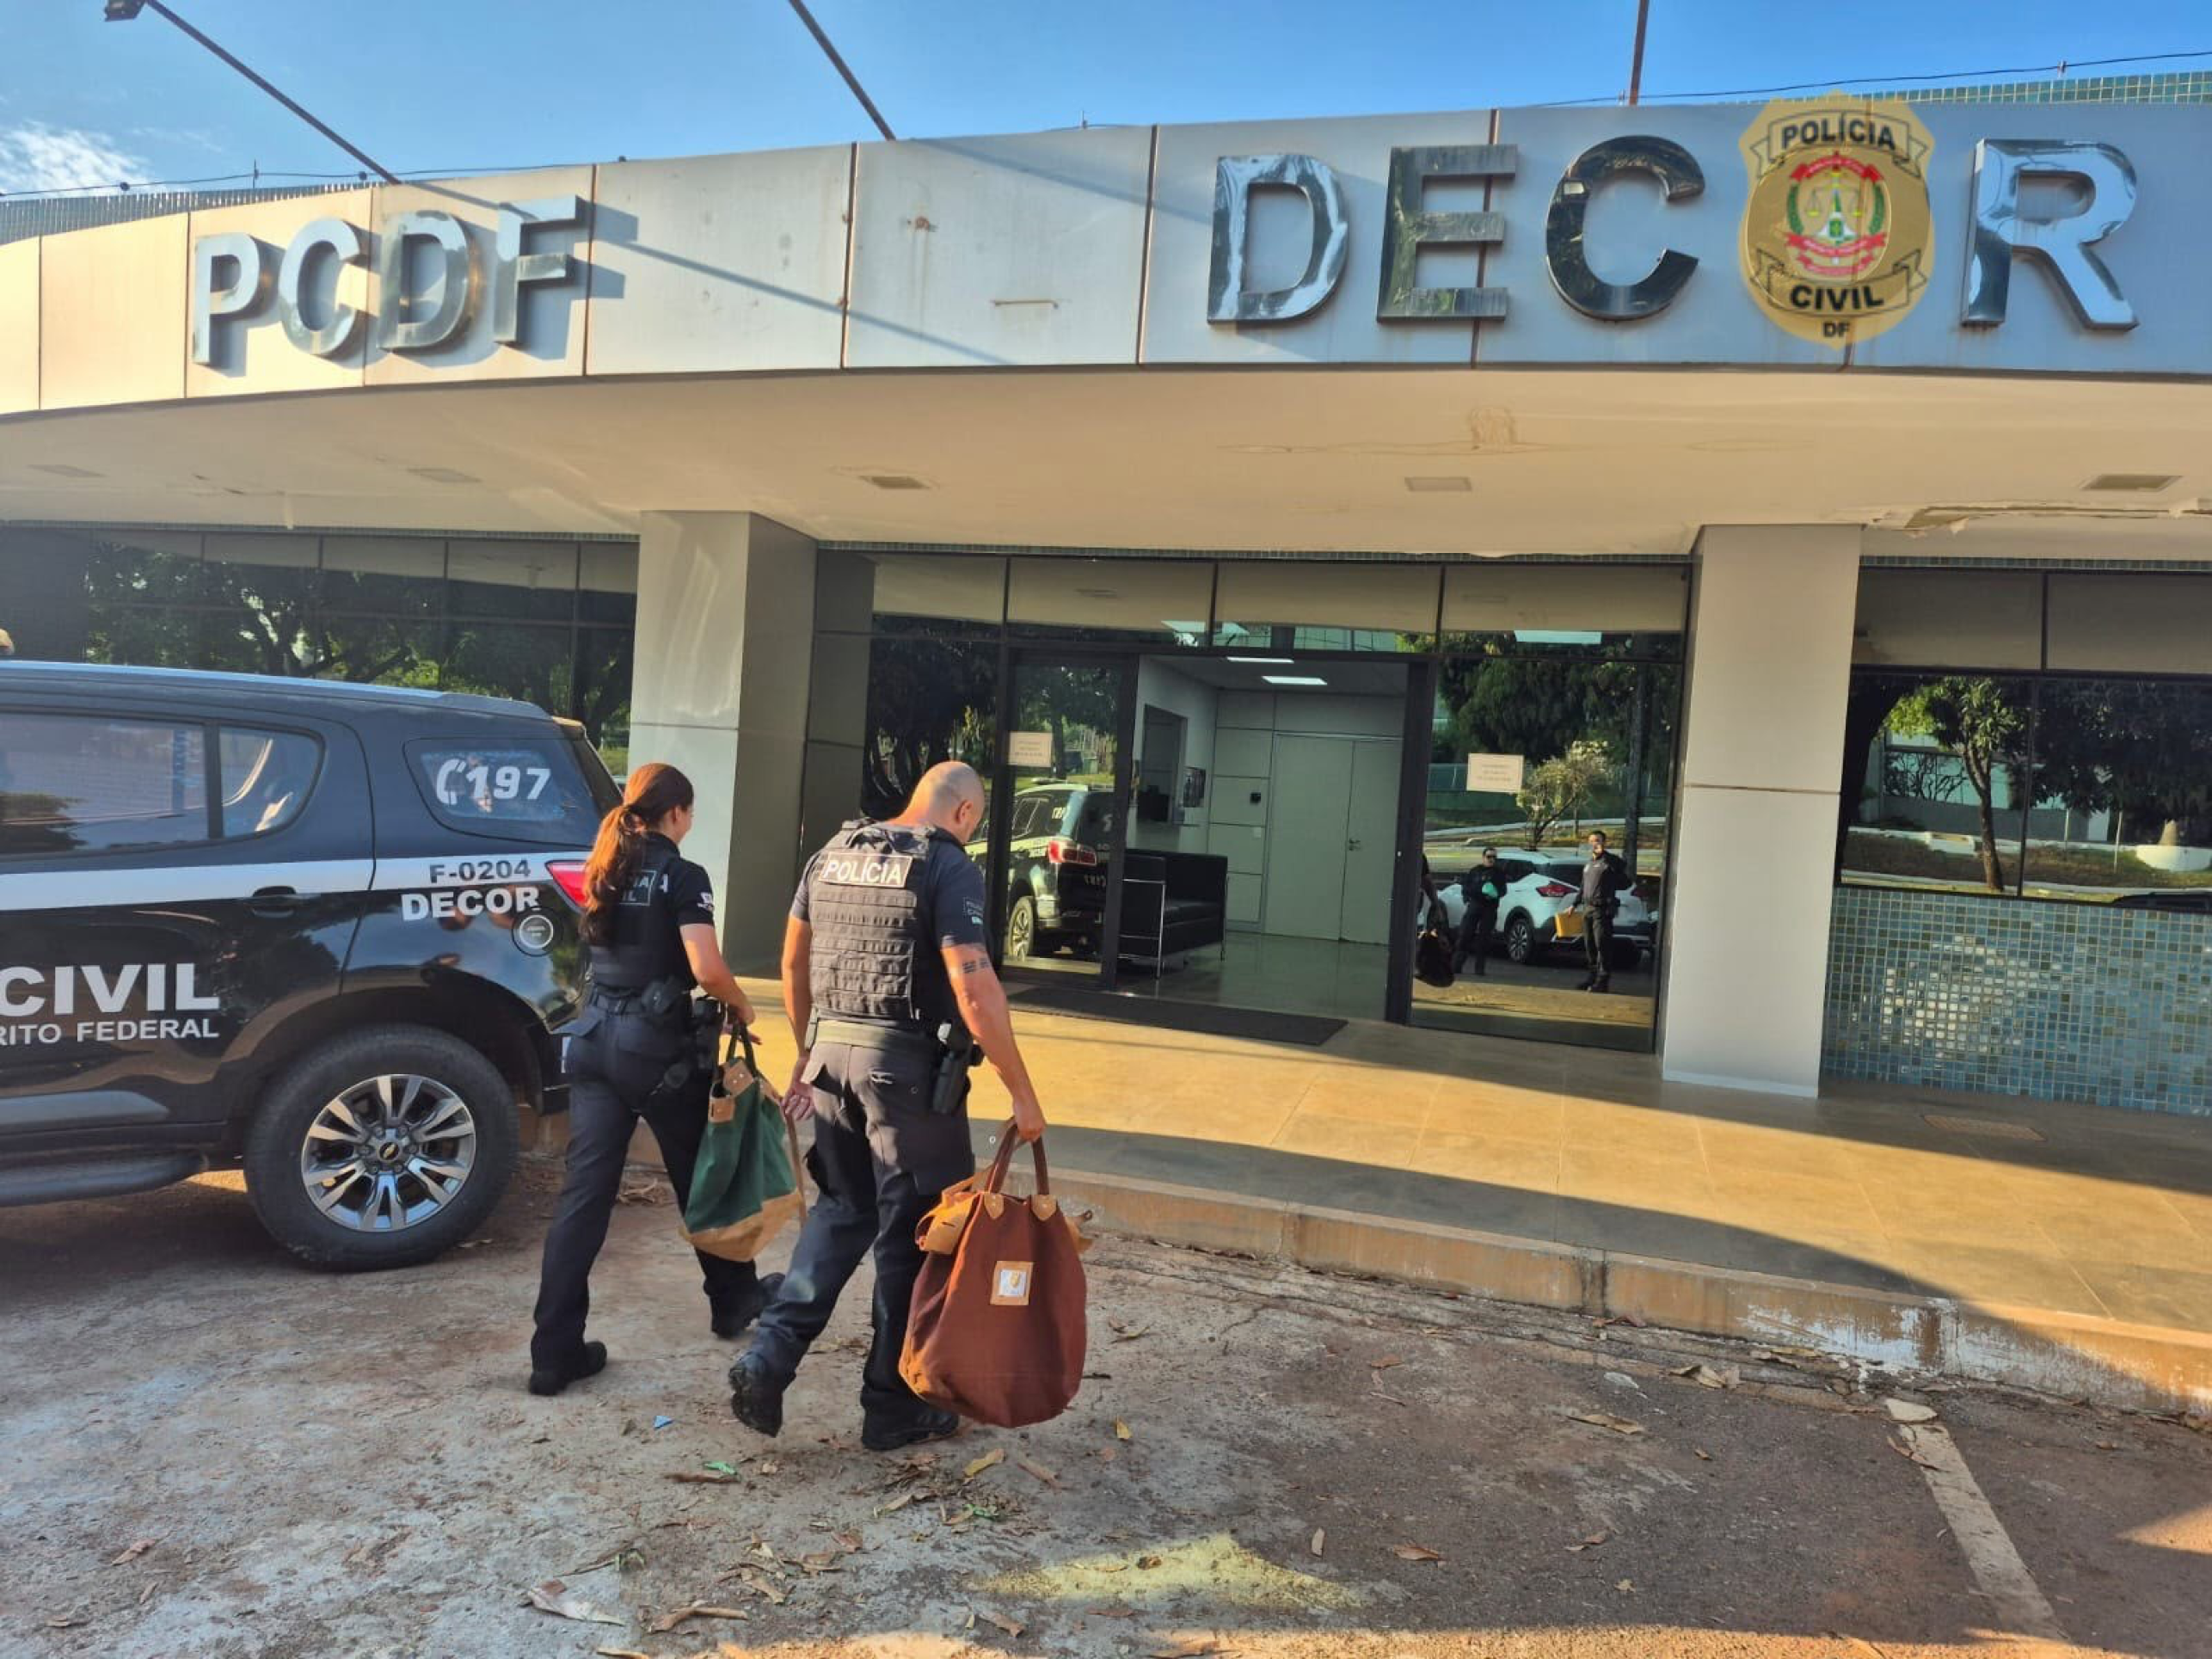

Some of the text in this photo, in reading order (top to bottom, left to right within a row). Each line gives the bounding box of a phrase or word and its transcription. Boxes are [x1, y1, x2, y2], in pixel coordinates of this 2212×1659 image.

[1781, 113, 1896, 150] POLÍCIA
[192, 194, 581, 366] PCDF
[1791, 285, 1885, 311] CIVIL
[1822, 322, 1850, 338] DF
[465, 765, 552, 801] 197
[430, 859, 531, 884] F-0204
[822, 856, 903, 886] POLÍCIA
[401, 886, 541, 921] DECOR
[0, 962, 221, 1017] CIVIL
[77, 1017, 220, 1042] FEDERAL
